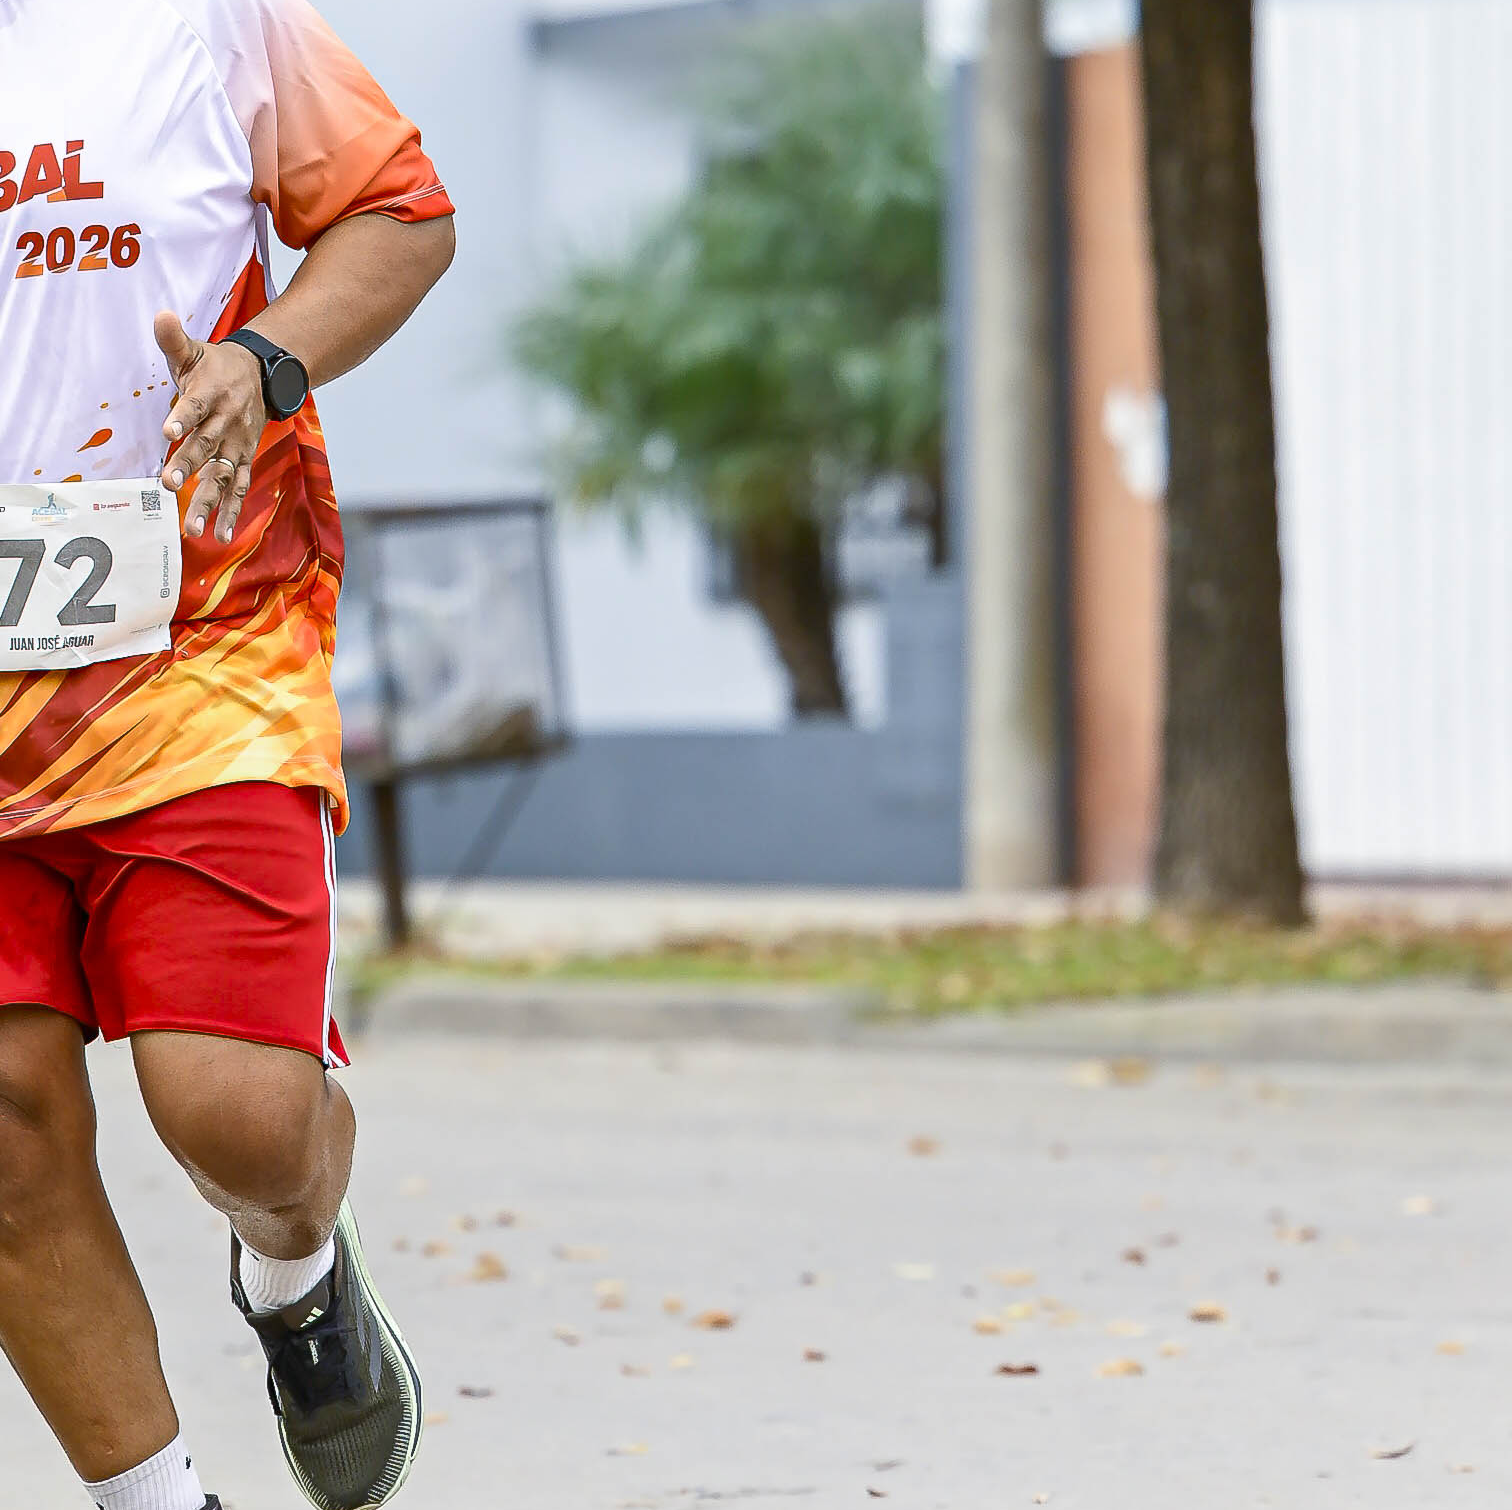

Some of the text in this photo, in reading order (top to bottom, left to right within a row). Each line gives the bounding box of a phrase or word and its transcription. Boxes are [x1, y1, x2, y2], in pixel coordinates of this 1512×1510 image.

[15, 223, 142, 279] 2026
[9, 637, 35, 651] JUAN
[37, 634, 60, 651] JOSÉ
